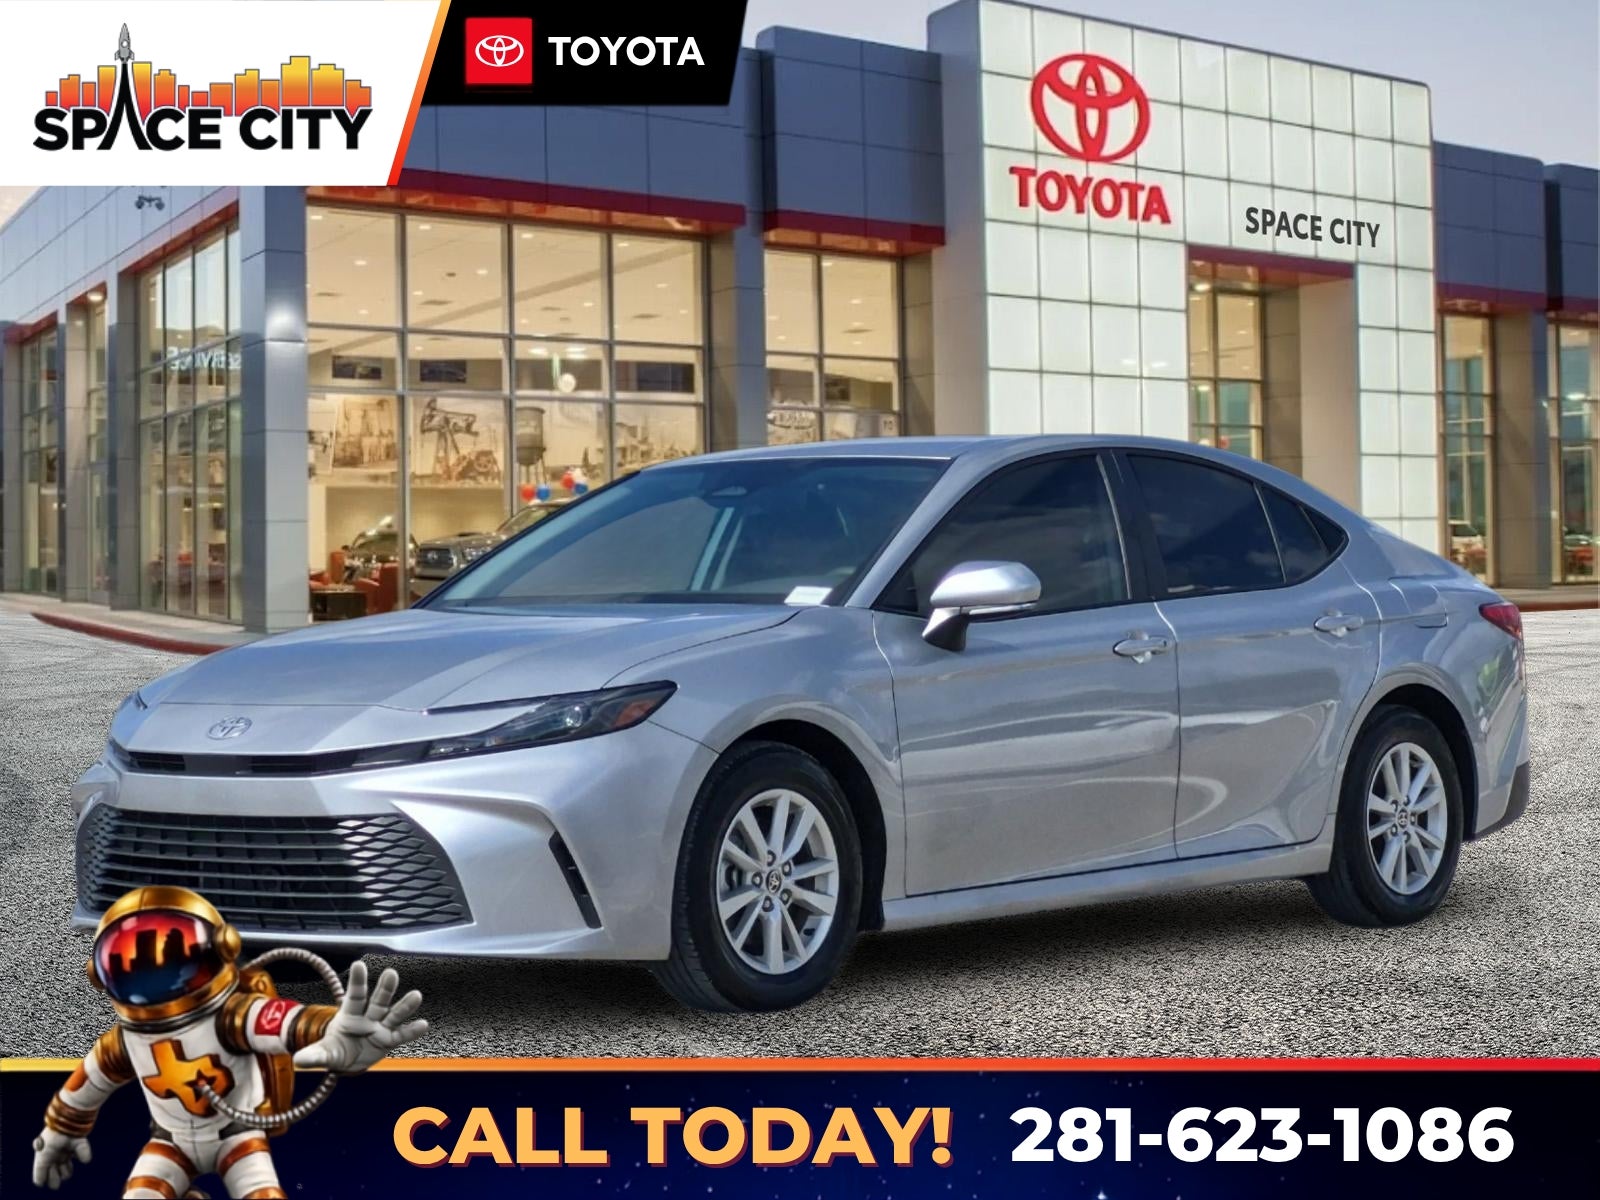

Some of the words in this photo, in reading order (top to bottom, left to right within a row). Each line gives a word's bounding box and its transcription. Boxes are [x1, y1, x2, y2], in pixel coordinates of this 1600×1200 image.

[1009, 166, 1171, 224] TOYOTA
[1245, 207, 1322, 242] SPACE
[1329, 218, 1380, 248] CITY
